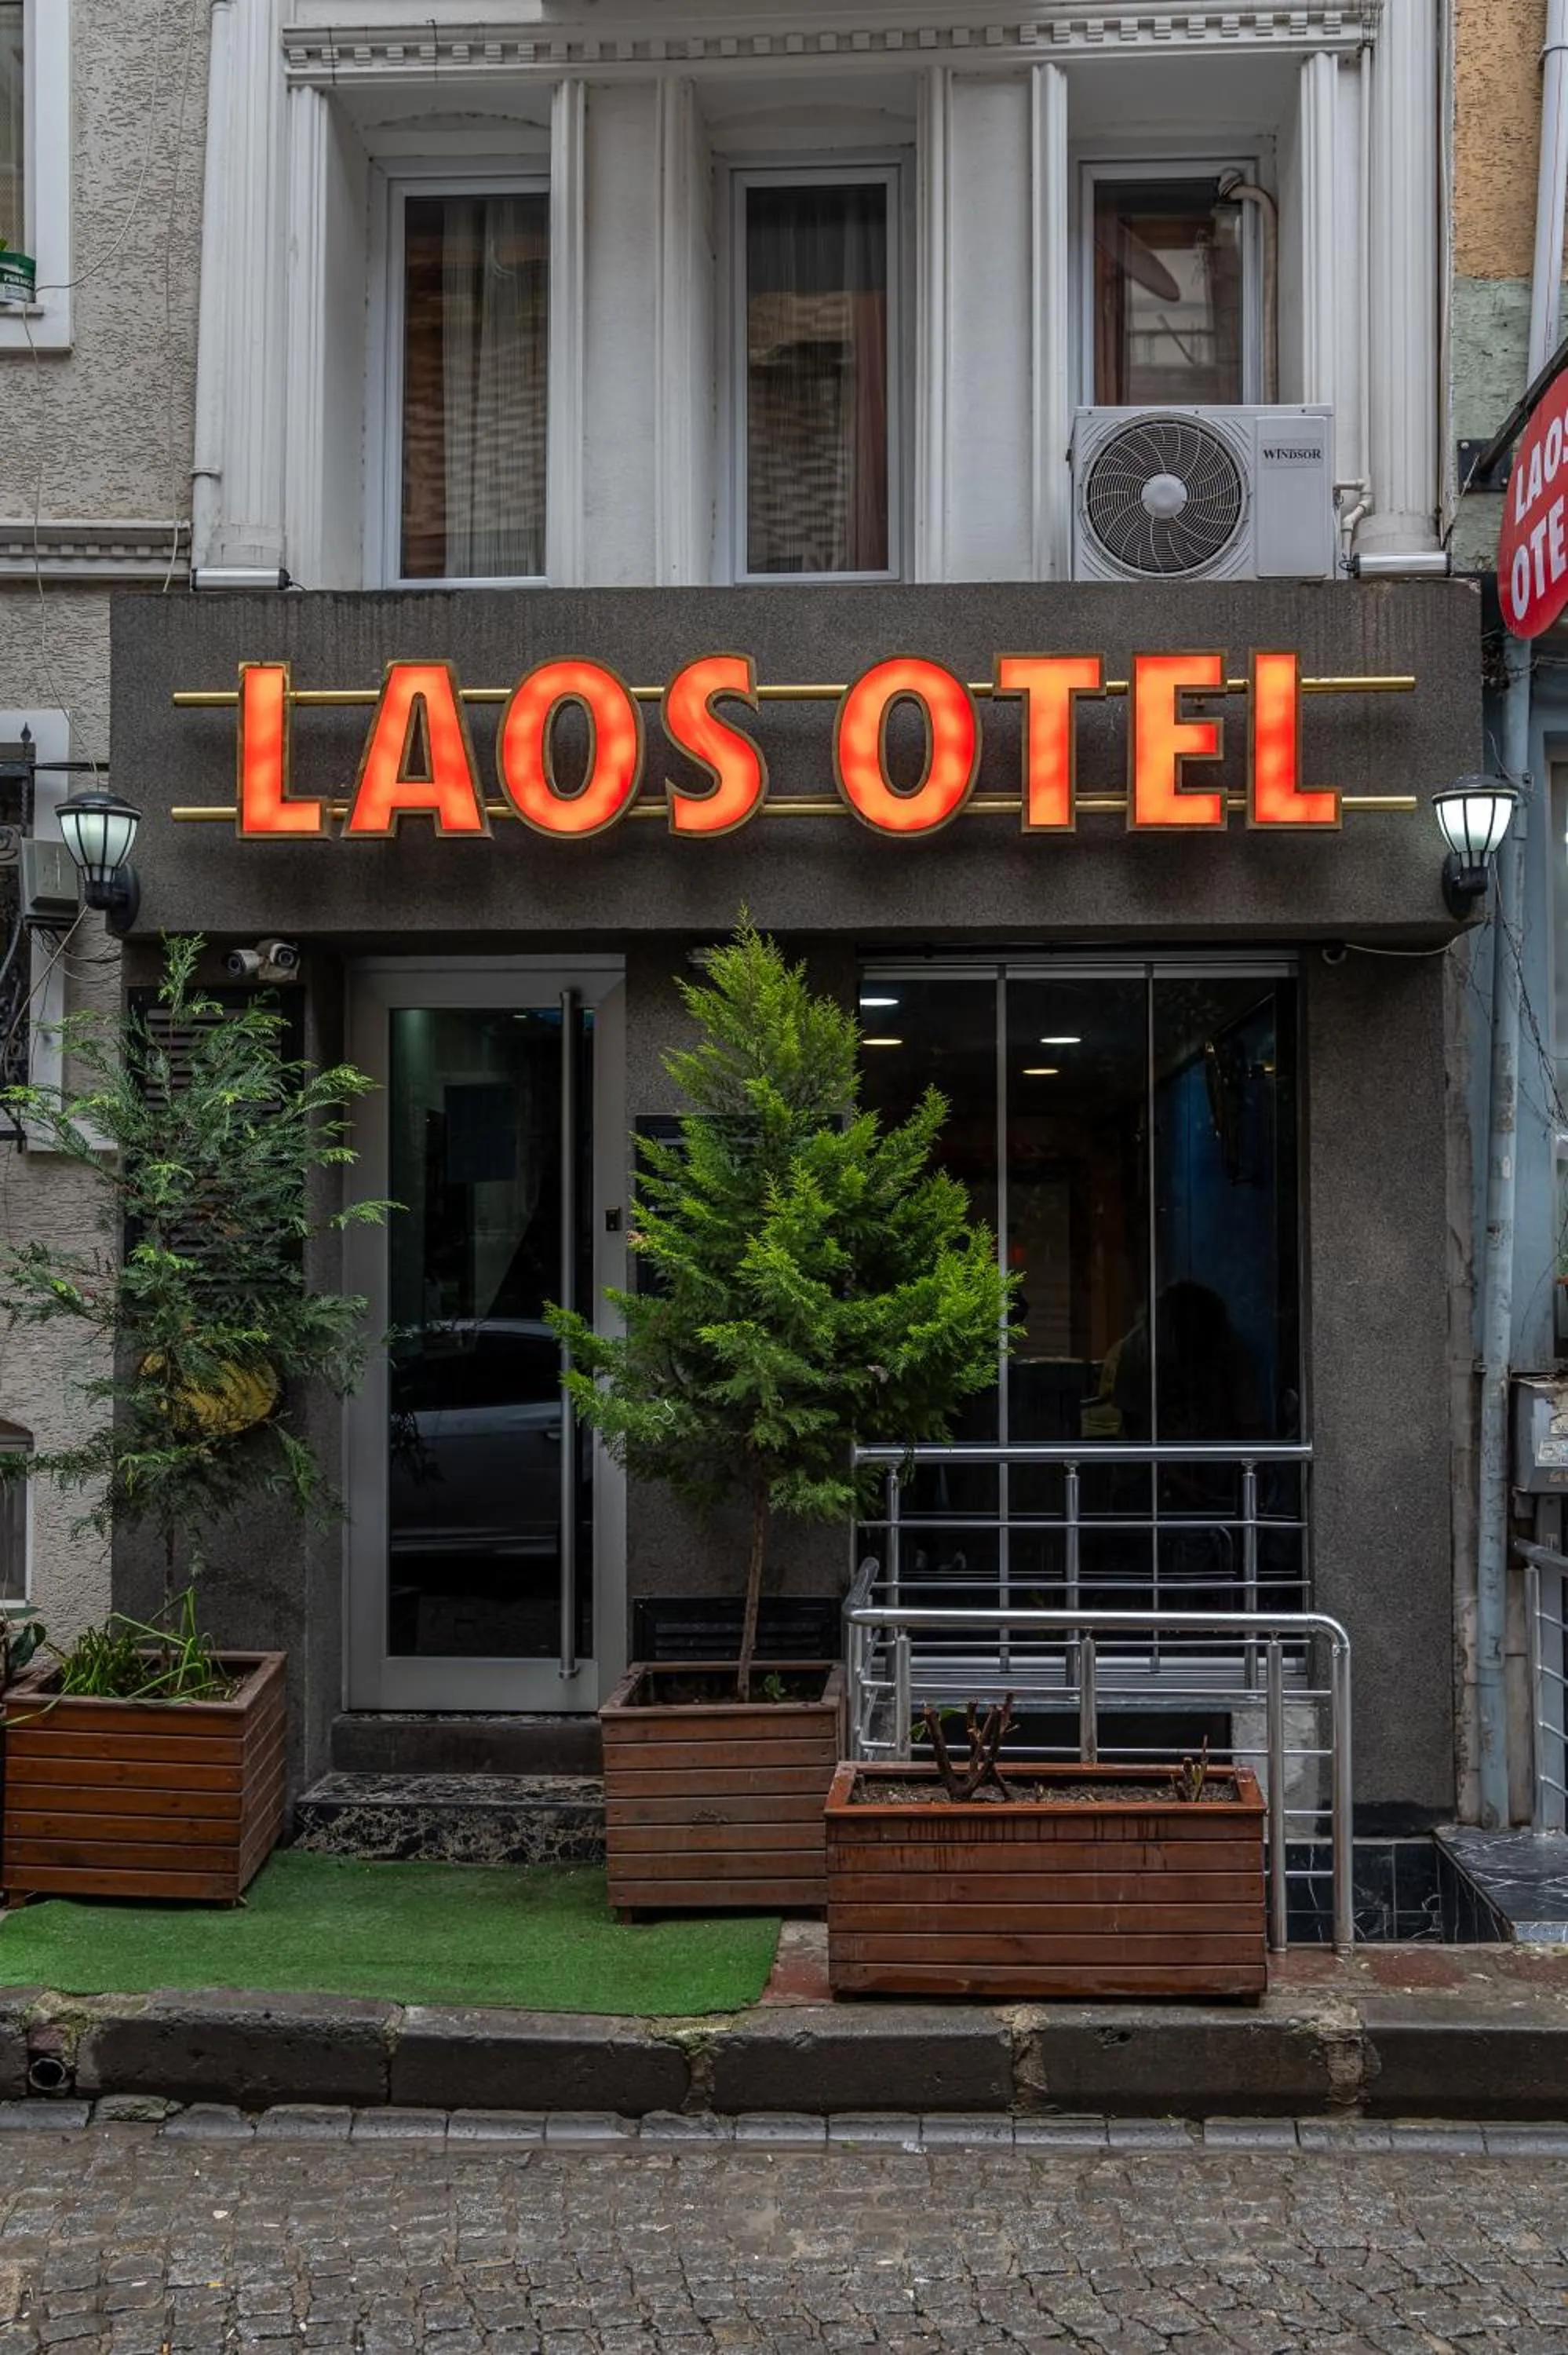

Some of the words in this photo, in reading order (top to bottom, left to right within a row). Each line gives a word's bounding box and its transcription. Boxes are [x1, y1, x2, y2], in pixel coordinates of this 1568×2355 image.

[1264, 448, 1322, 459] WINDSOR
[236, 652, 768, 840] LAOS
[832, 648, 1343, 838] OTEL
